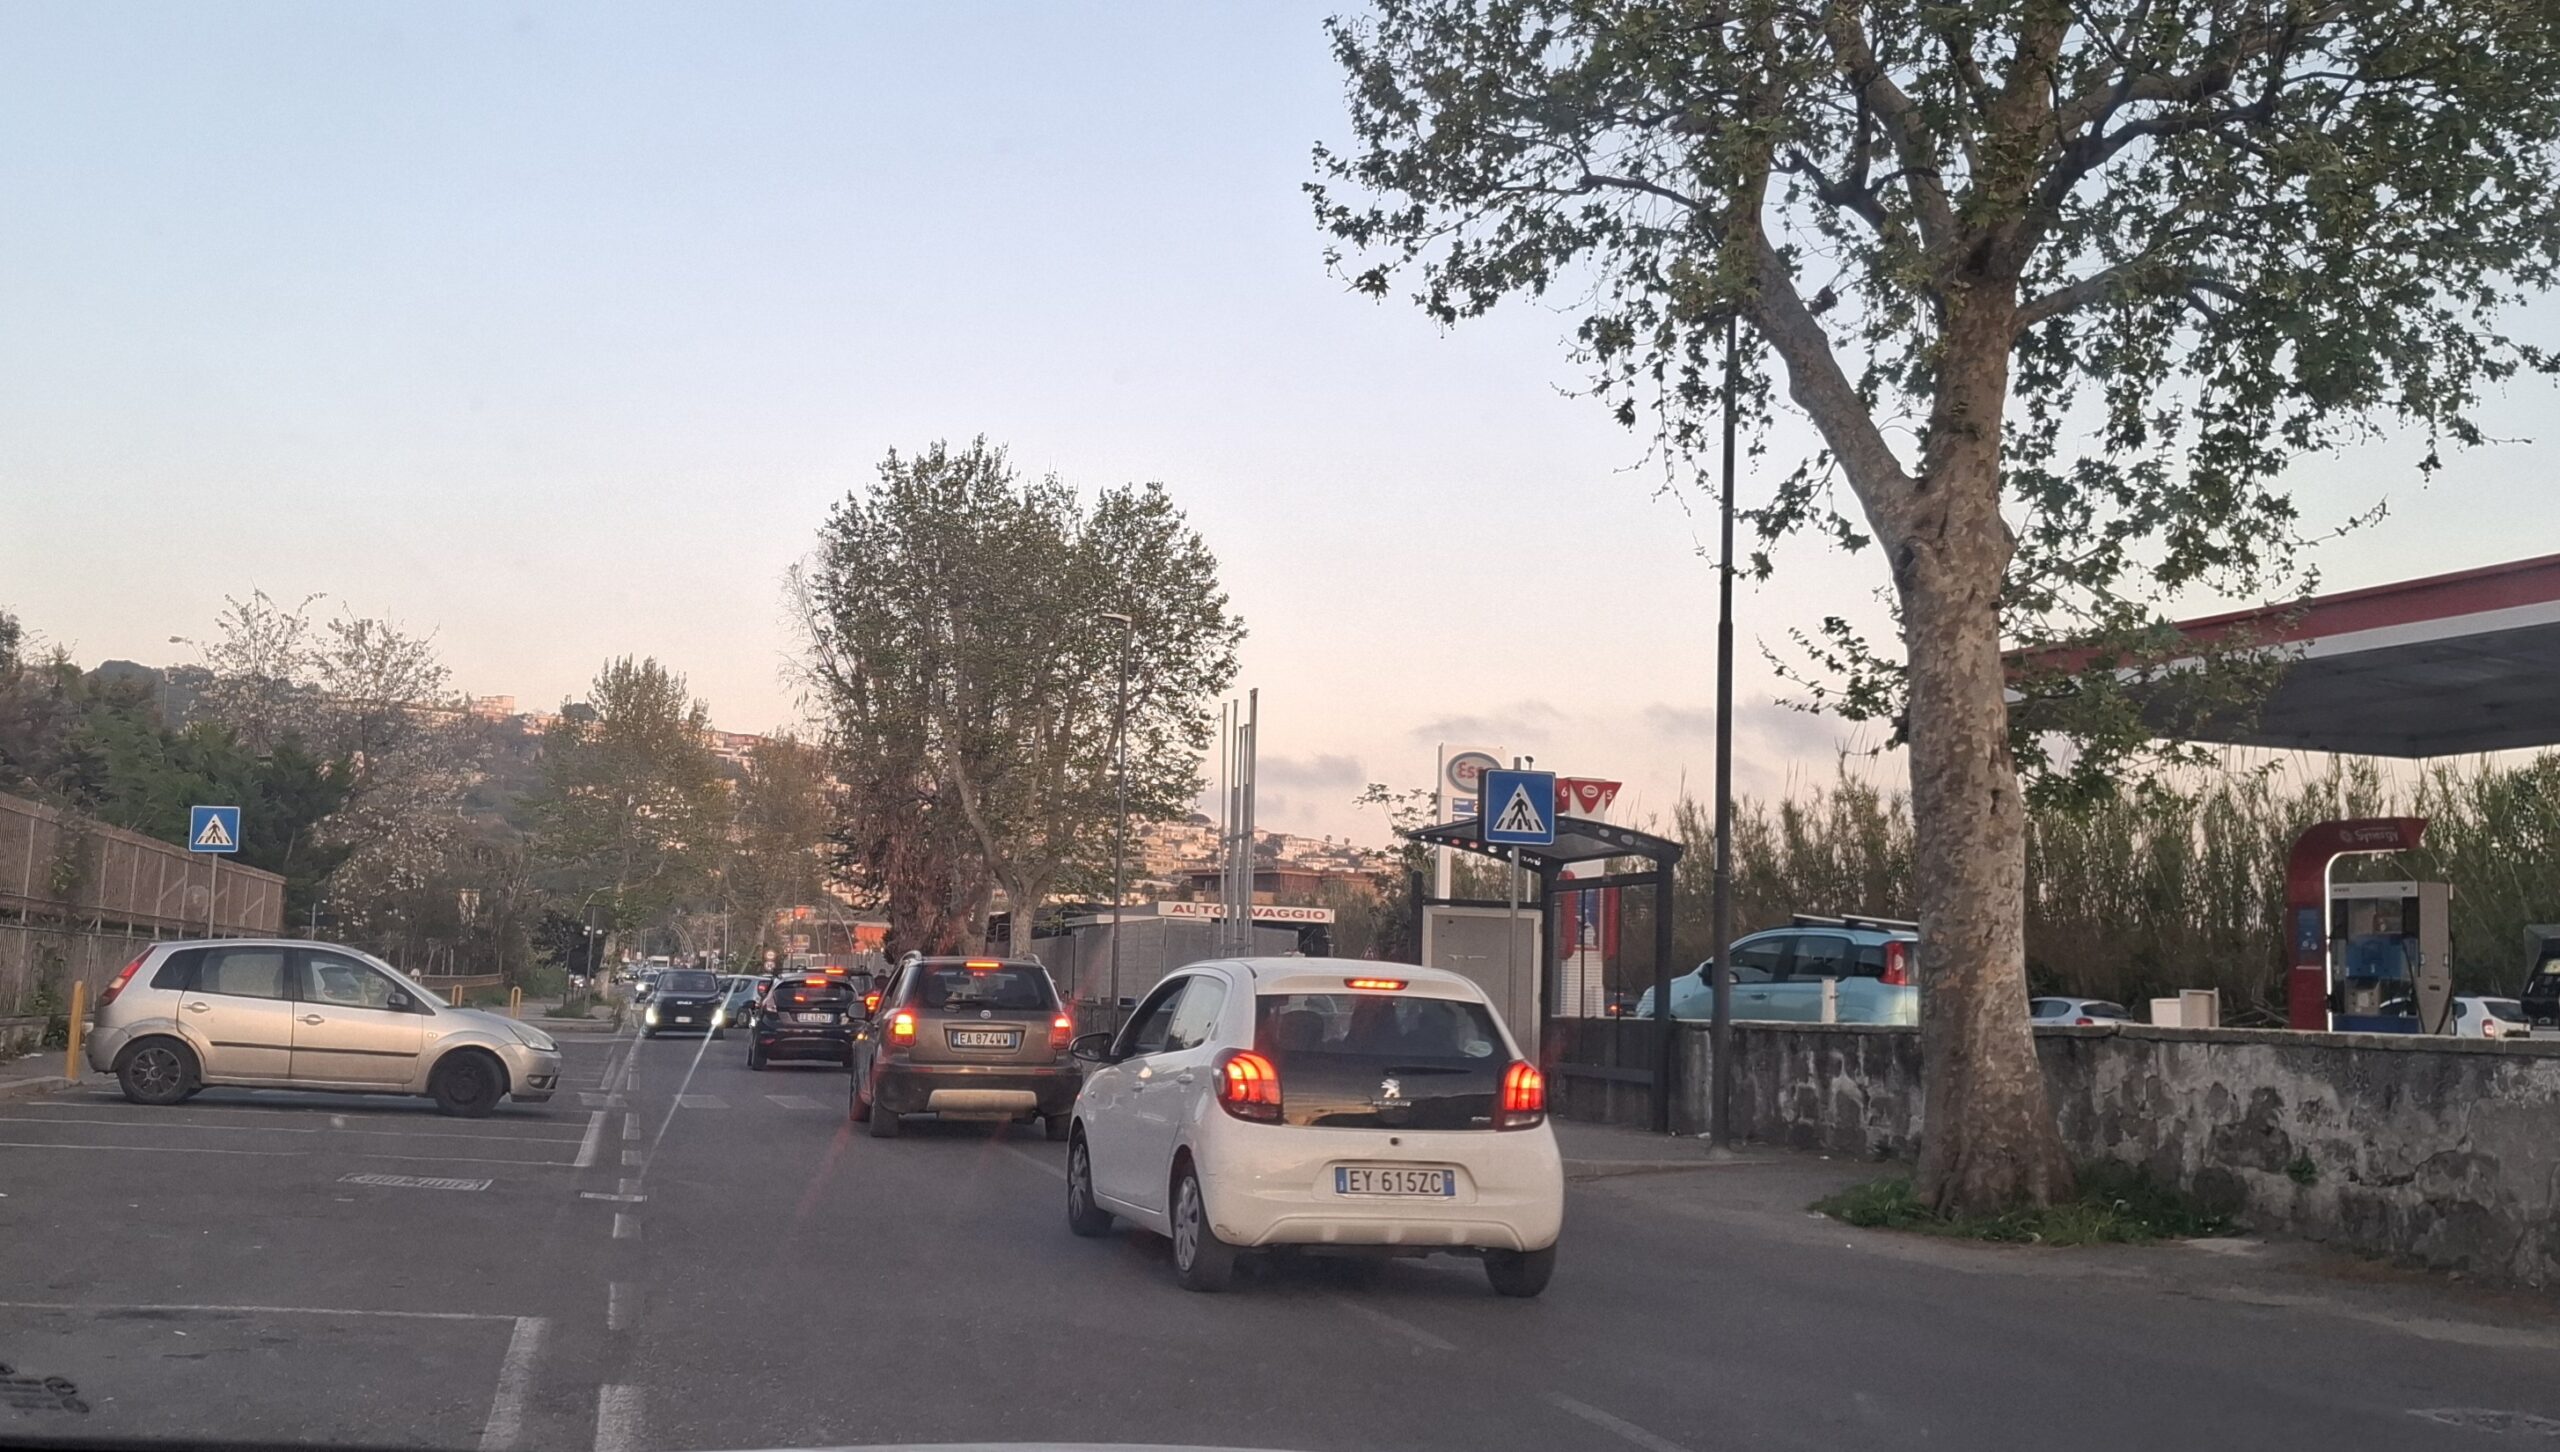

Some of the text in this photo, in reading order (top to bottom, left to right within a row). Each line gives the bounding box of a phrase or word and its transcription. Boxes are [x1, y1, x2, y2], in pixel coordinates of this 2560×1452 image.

[1606, 790, 1613, 800] 5
[960, 1033, 972, 1044] EA
[1350, 1170, 1372, 1192] EY
[1381, 1171, 1441, 1193] 615ZC
